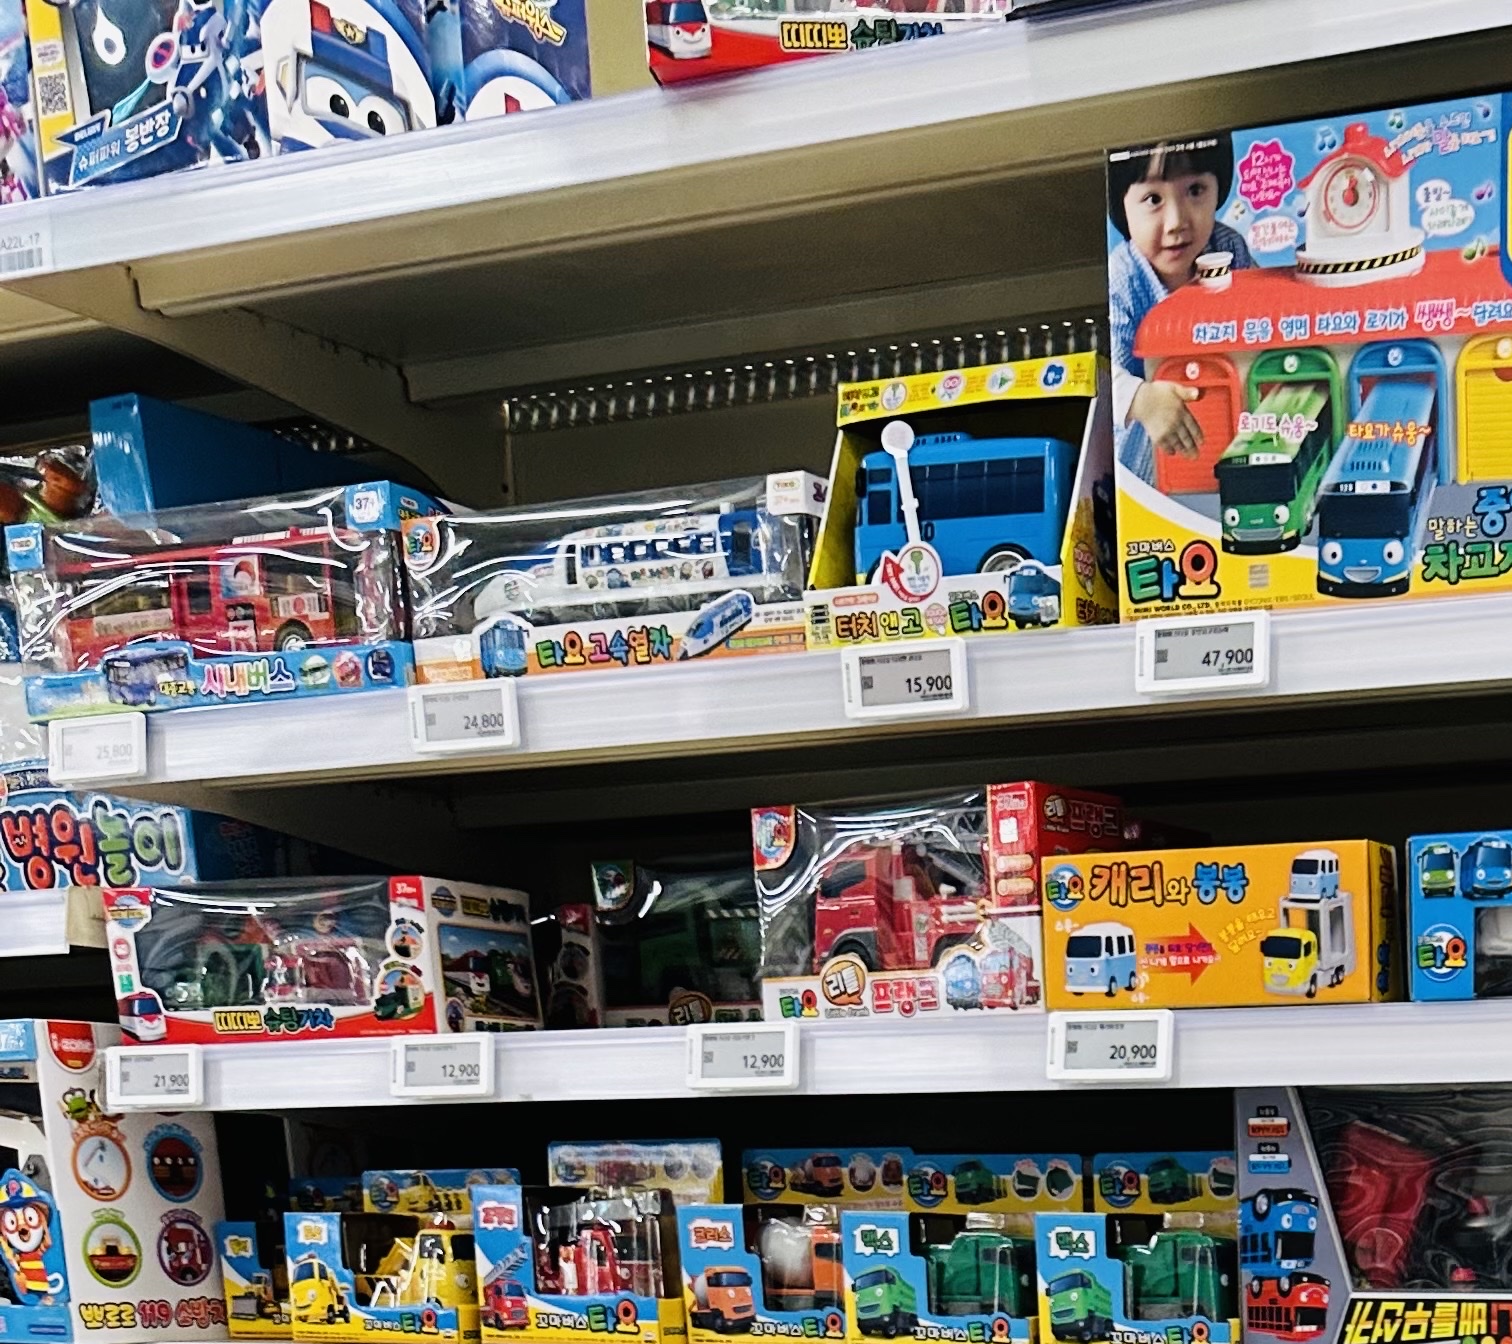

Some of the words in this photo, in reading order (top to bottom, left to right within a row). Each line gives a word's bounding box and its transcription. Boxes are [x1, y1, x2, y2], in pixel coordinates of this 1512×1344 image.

[779, 20, 849, 51] 띠띠뽀
[77, 140, 121, 171] 슈퍼파워
[123, 110, 172, 153] 봉반장
[1194, 322, 1236, 344] 차고지
[1243, 320, 1271, 343] 문을
[1279, 315, 1310, 341] 열면
[1316, 313, 1361, 336] 타요와
[1366, 309, 1409, 333] 로기가
[1238, 411, 1278, 434] 로기도
[1348, 422, 1391, 440] 타요가
[1426, 516, 1479, 538] 말하는
[1125, 538, 1176, 556] 꼬마버스
[1124, 539, 1221, 604] 타요
[950, 590, 1009, 633] 타요
[536, 636, 587, 668] 타요
[588, 628, 674, 666] 고속열차
[1201, 648, 1254, 668] 47,900
[200, 658, 296, 697] 시내버스
[905, 674, 953, 697] 15,900
[463, 713, 505, 732] 24,800
[1046, 880, 1085, 904] 타요
[1191, 862, 1250, 903] 봉봉
[1416, 935, 1468, 970] 타요
[780, 987, 819, 1020] 타요
[872, 976, 940, 1019] 프랭크
[213, 1010, 264, 1032] 띠띠뽀
[264, 1005, 336, 1036] 슈팅기차
[743, 1053, 785, 1070] 12,900
[1109, 1043, 1158, 1062] 20,900
[153, 1072, 190, 1088] 21,900
[441, 1063, 481, 1079] 12,900
[693, 1222, 732, 1244] 크리스
[79, 1301, 138, 1330] 뽀로로
[137, 1299, 174, 1328] 119
[402, 1308, 440, 1336] 타요
[536, 1312, 589, 1331] 꼬마버스
[588, 1298, 641, 1336] 타요
[751, 1319, 803, 1338] 꼬마버스
[803, 1311, 846, 1340] 타요
[914, 1326, 968, 1343] 꼬마버스
[968, 1311, 1012, 1344] 타요
